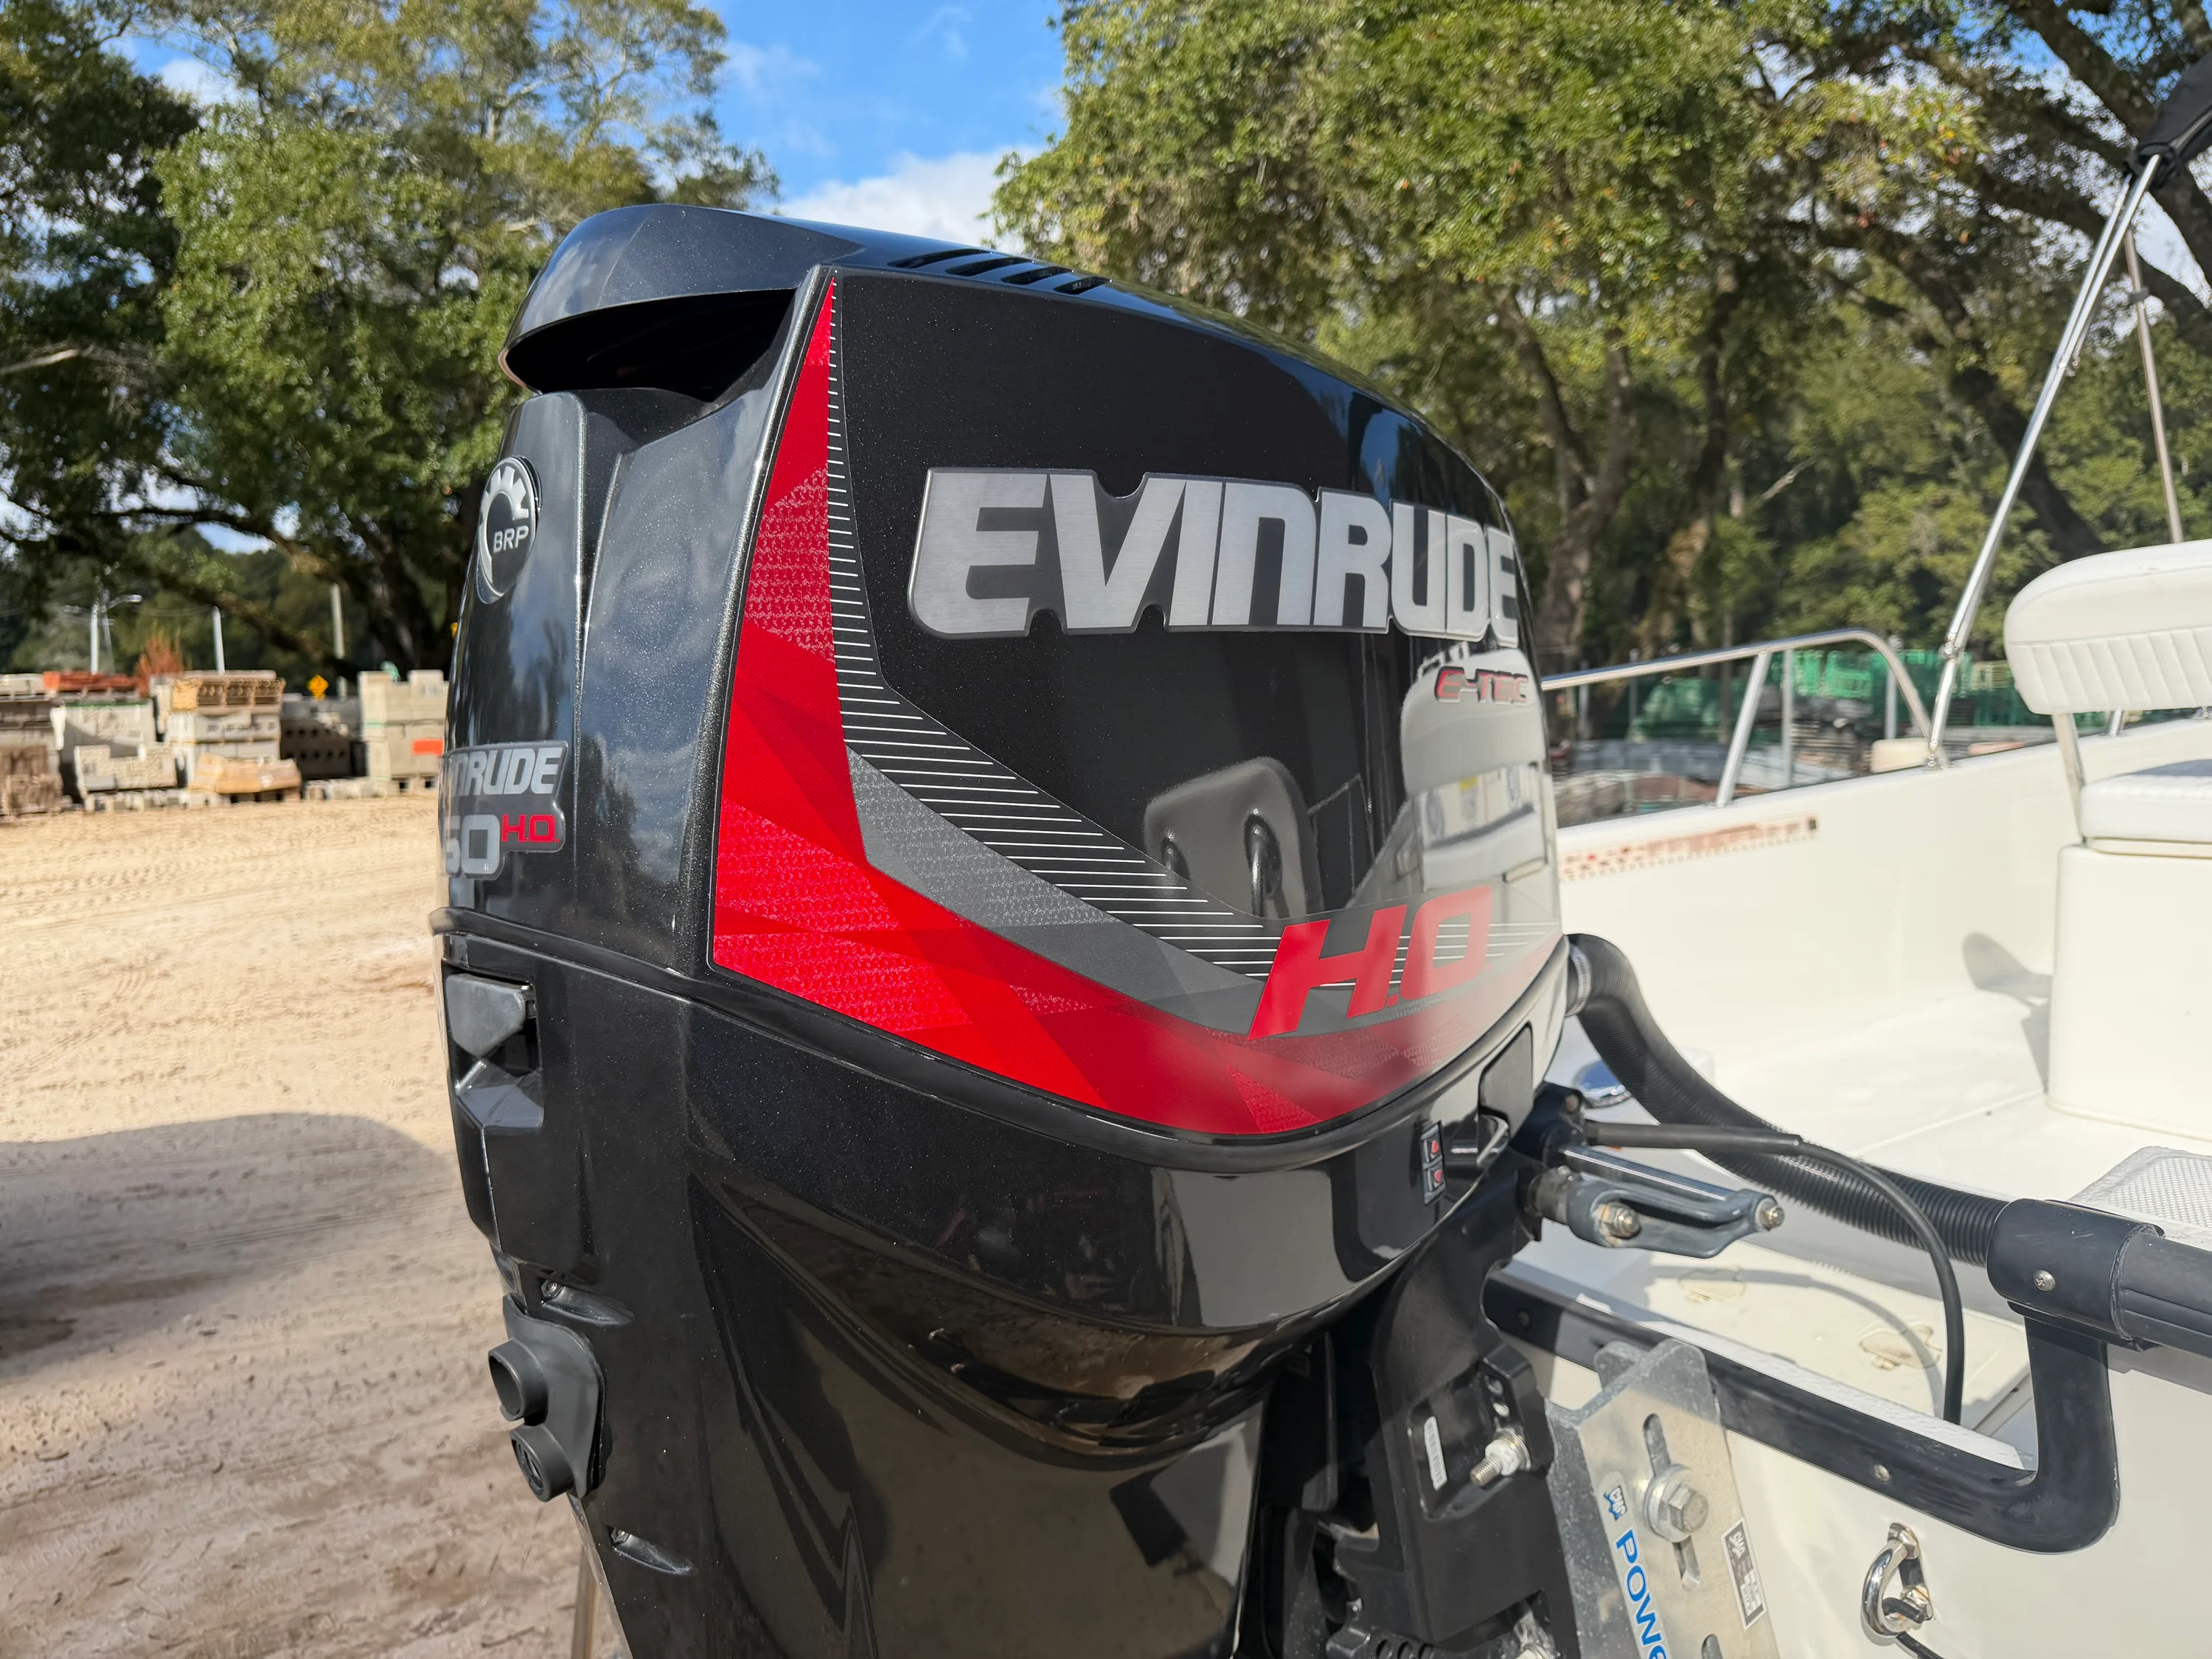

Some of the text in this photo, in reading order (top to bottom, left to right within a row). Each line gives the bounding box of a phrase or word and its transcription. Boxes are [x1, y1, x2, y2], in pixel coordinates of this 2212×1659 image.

[493, 525, 529, 553] BRP
[911, 472, 1520, 646] EVINRUDE
[1436, 668, 1528, 704] E-TEC
[449, 747, 563, 796] NRUDE
